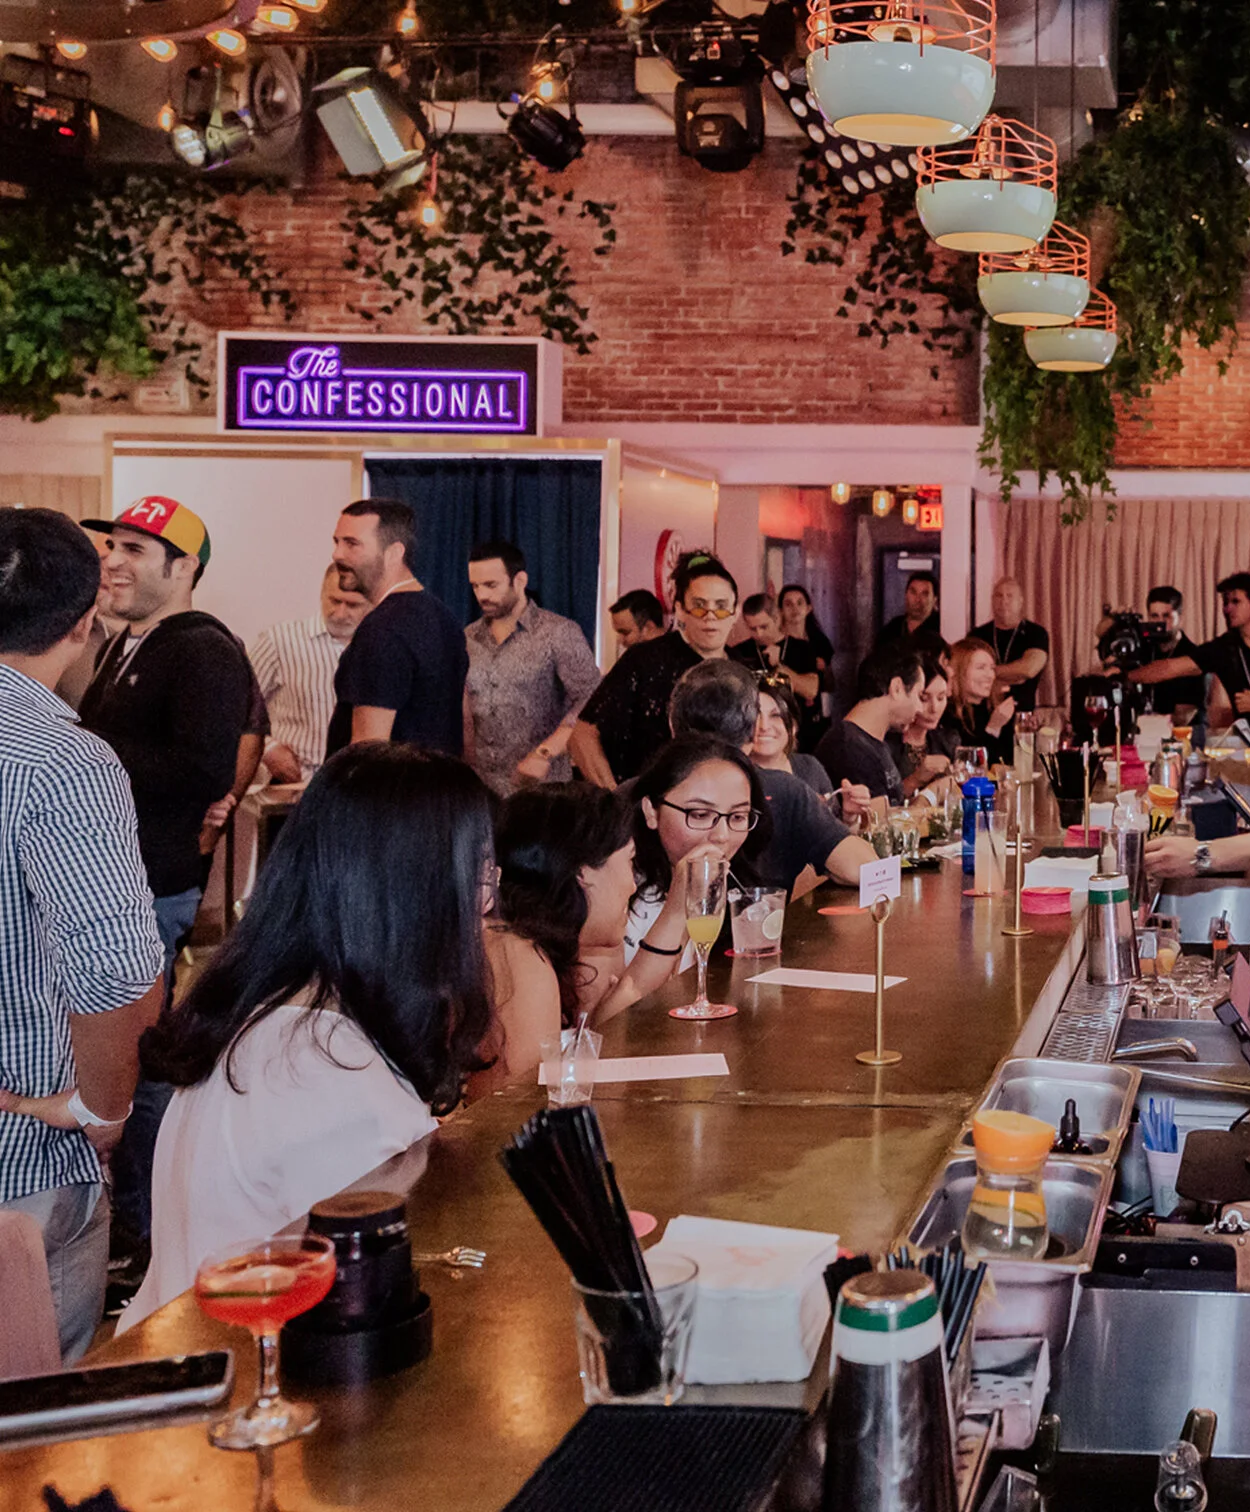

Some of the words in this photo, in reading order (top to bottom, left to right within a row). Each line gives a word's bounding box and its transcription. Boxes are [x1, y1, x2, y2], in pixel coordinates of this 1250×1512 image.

[287, 345, 341, 380] The
[251, 379, 514, 419] CONFESSIONAL
[921, 507, 943, 528] EXI
